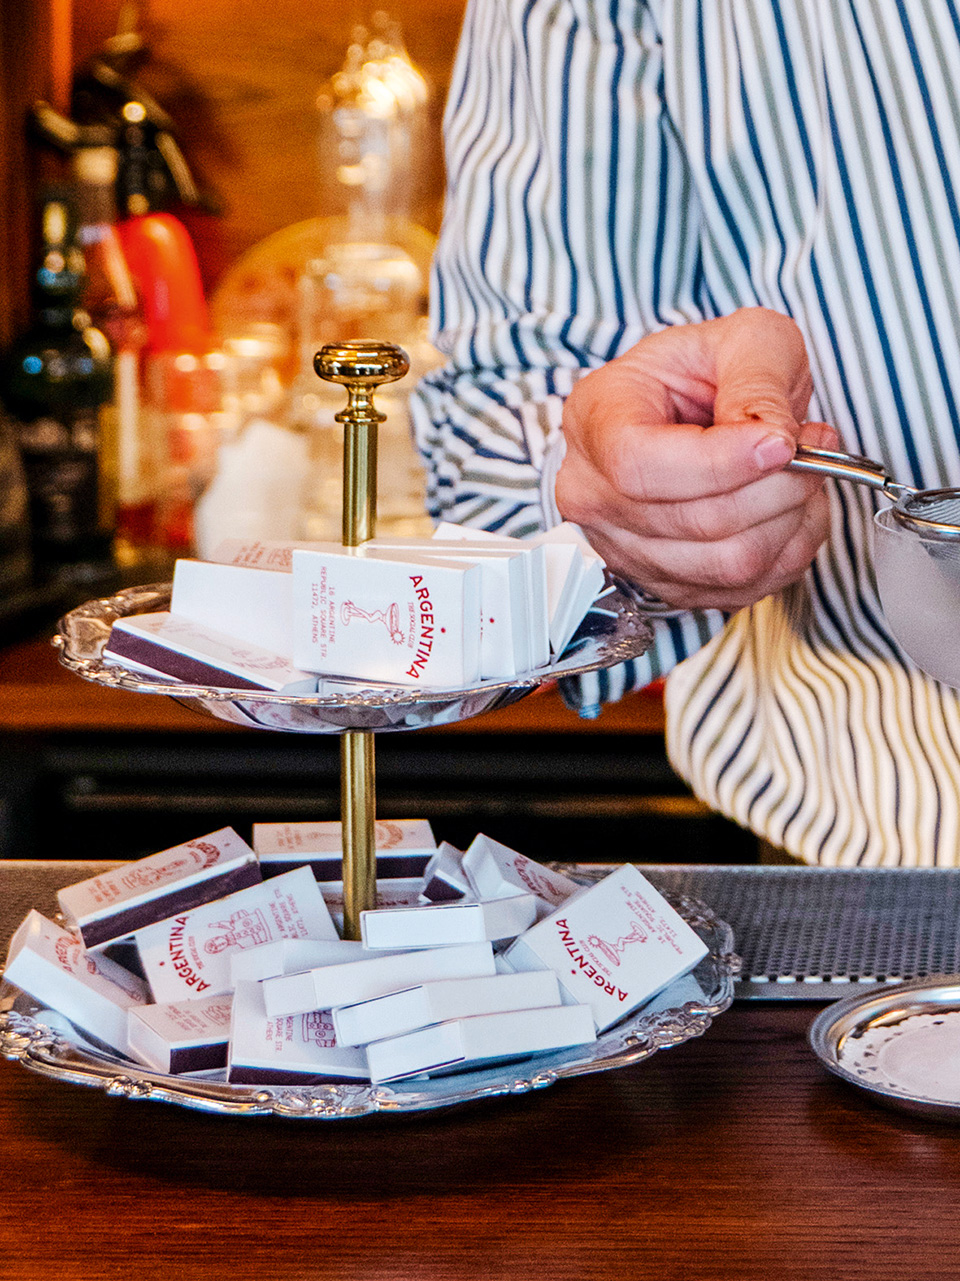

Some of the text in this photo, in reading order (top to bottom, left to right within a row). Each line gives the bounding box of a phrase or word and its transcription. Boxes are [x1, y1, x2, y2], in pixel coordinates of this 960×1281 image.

[406, 575, 434, 679] ARGENTINA
[626, 901, 656, 933] ARGENTINE
[634, 900, 655, 922] SQUARE
[635, 891, 656, 913] ATHENS
[169, 916, 211, 992] ARGENTINA
[556, 919, 628, 1002] ARGENTINA
